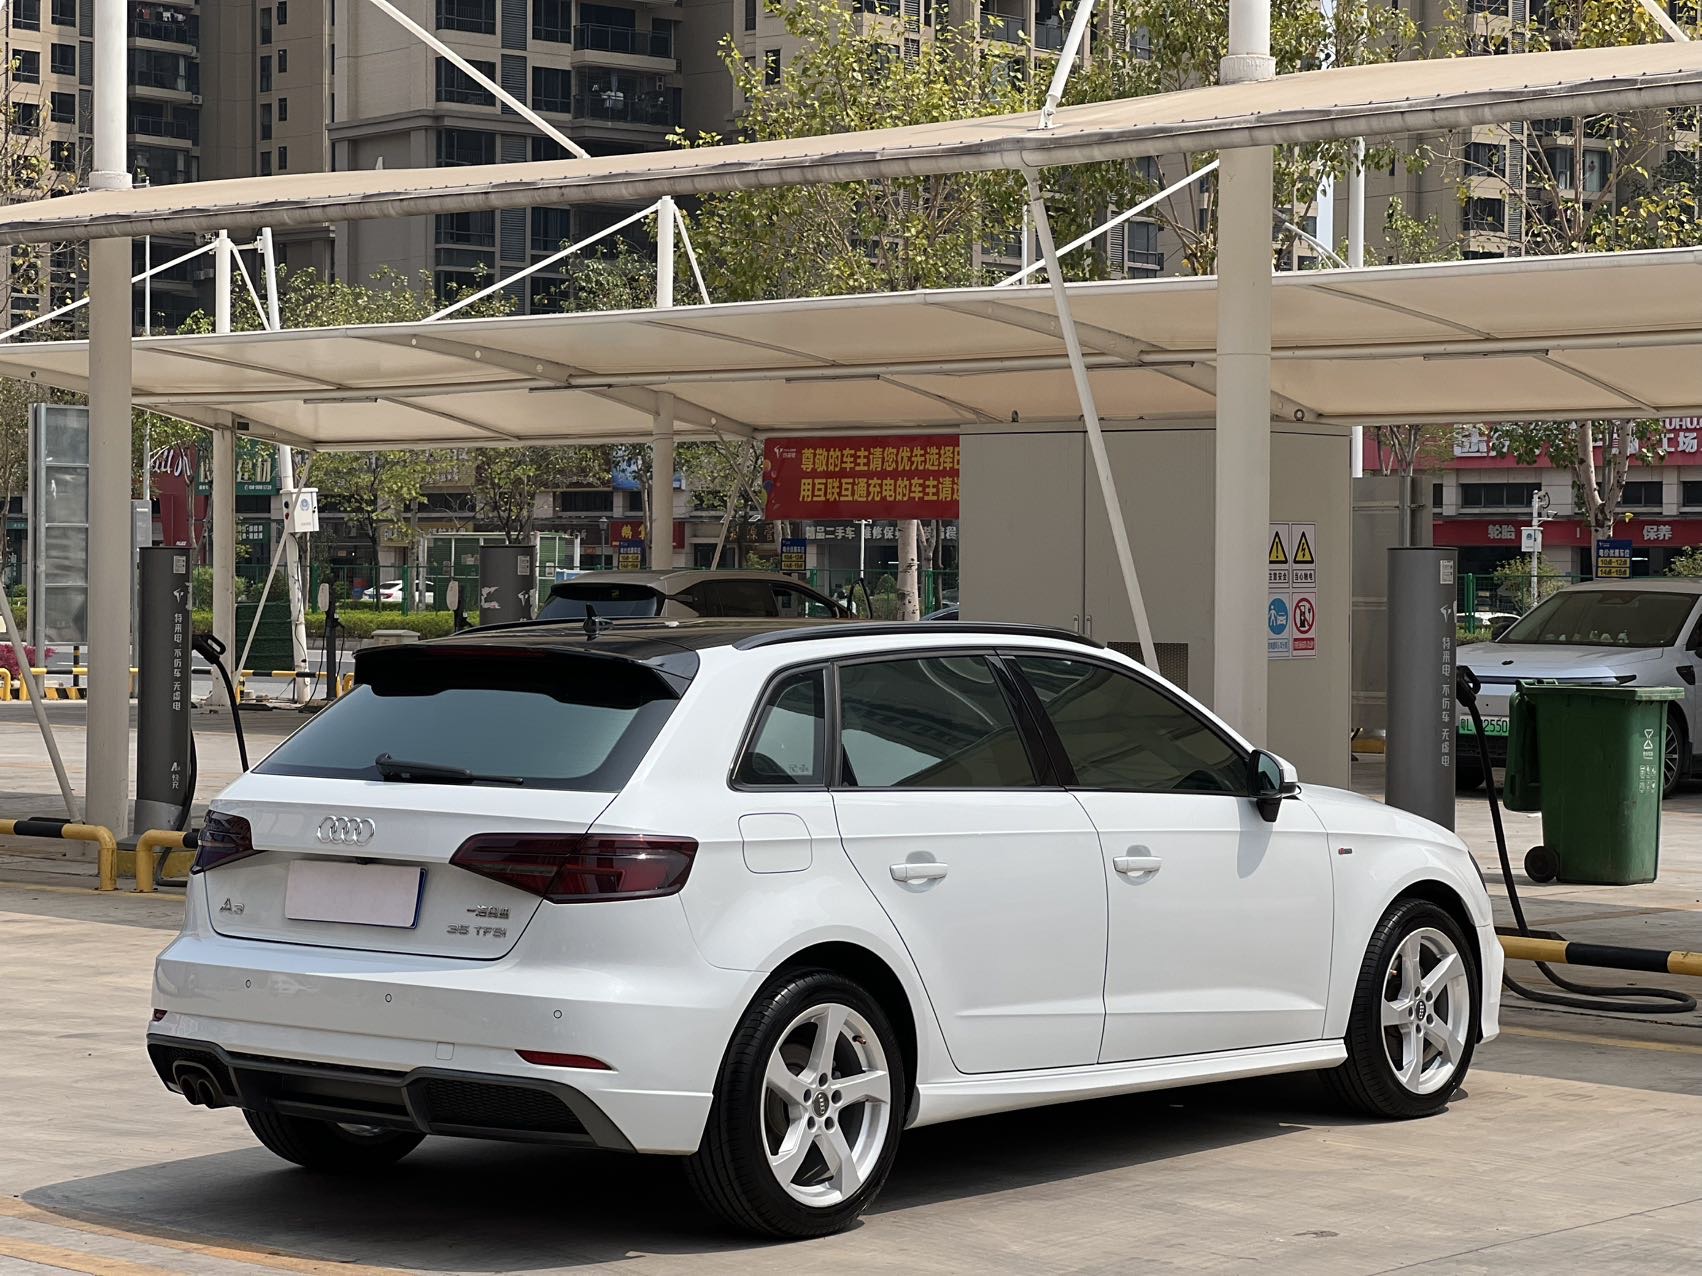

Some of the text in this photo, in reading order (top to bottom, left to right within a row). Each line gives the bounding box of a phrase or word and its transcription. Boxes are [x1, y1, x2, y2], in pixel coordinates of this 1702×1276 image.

[1487, 524, 1516, 540] 轮胎
[1642, 525, 1672, 541] 保养
[219, 897, 245, 915] A3
